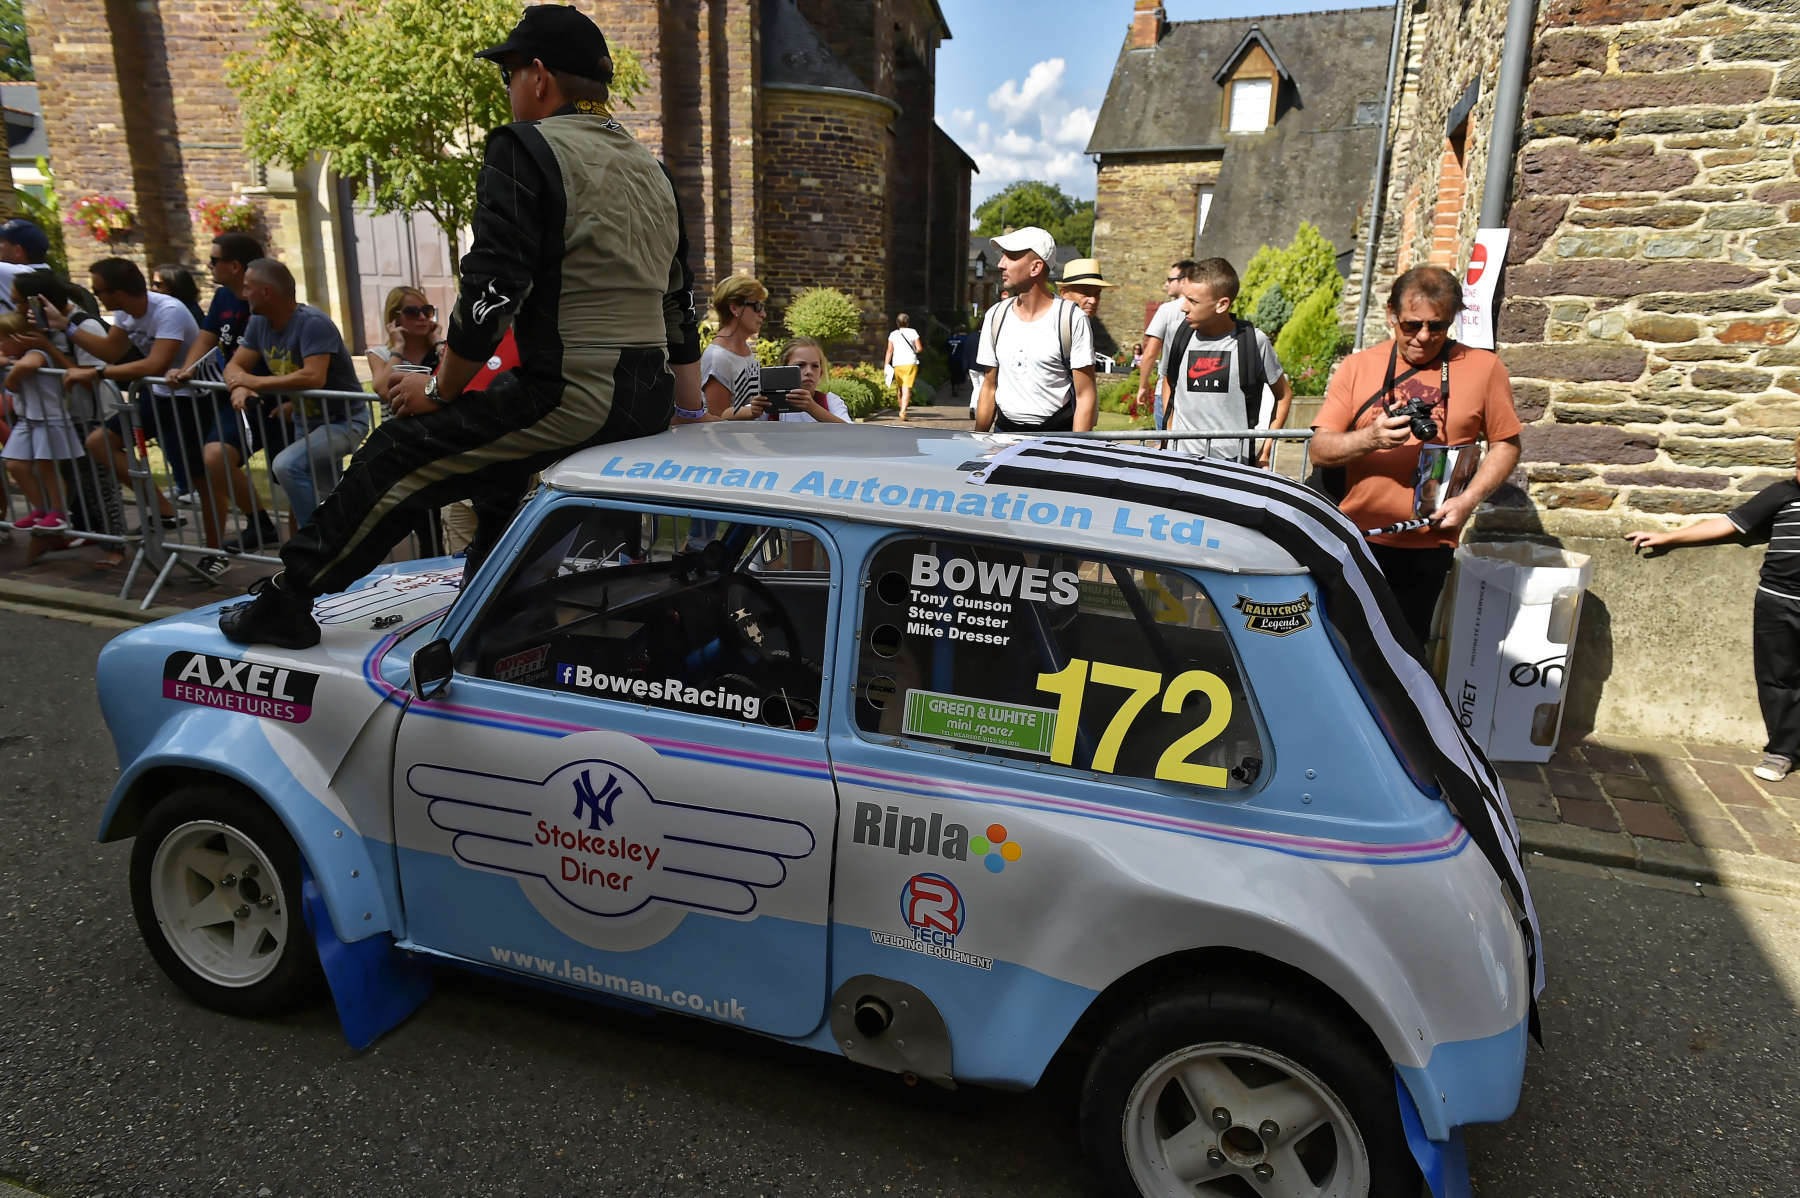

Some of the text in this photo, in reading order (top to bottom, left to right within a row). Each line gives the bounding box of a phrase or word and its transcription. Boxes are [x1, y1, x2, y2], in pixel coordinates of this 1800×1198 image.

[1193, 379, 1220, 387] AIR
[601, 455, 1221, 550] Labman Automation Ltd.
[910, 553, 1080, 606] BOWES
[908, 606, 1009, 629] Steve Foster
[910, 589, 1012, 613] Tony Gunson
[1245, 601, 1307, 616] RALLYCROSS
[907, 622, 1010, 646] Mike Dresser
[1260, 616, 1300, 630] Legends
[177, 654, 295, 701] AXEL
[575, 664, 760, 720] BowesRacing
[175, 684, 295, 720] FERMETURES
[928, 699, 1037, 727] GREEN & WHITE
[946, 719, 1014, 738] mini spares
[1036, 658, 1233, 788] 172
[572, 768, 623, 831] NY
[535, 820, 660, 870] Stokesley
[853, 802, 969, 861] Ripla
[561, 856, 633, 892] Diner
[871, 930, 993, 970] WELDING EQUIPMENT
[911, 925, 955, 948] TECH
[490, 946, 745, 1021] www.labman.co.uk
